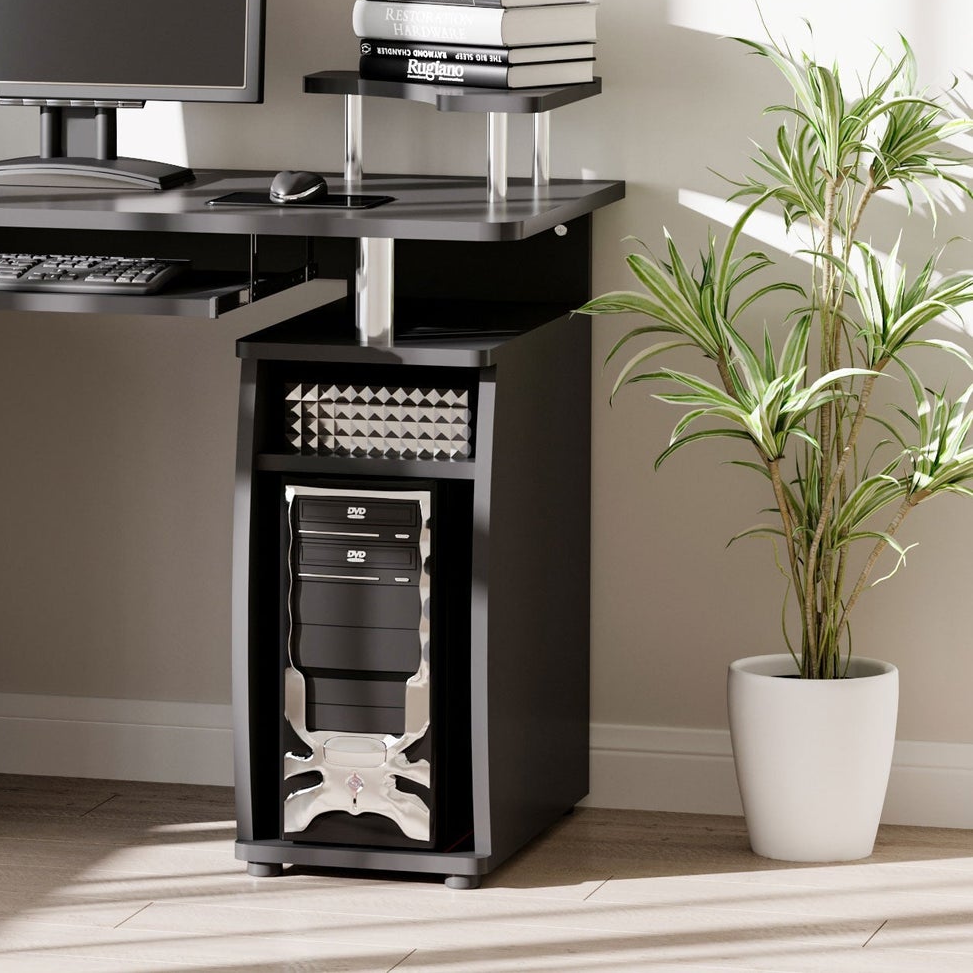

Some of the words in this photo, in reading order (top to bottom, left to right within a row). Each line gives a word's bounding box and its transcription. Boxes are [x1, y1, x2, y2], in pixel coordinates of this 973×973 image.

[385, 7, 473, 25] RESTORATION
[394, 23, 468, 40] HARDWARE
[376, 47, 411, 57] CHANDLER
[412, 49, 447, 59] RAYMOND
[454, 52, 474, 61] SLEEP
[475, 53, 488, 62] BIG
[489, 54, 502, 63] THE
[407, 58, 465, 81] Rugiano
[347, 507, 367, 516] DVD
[347, 550, 367, 559] DVD
